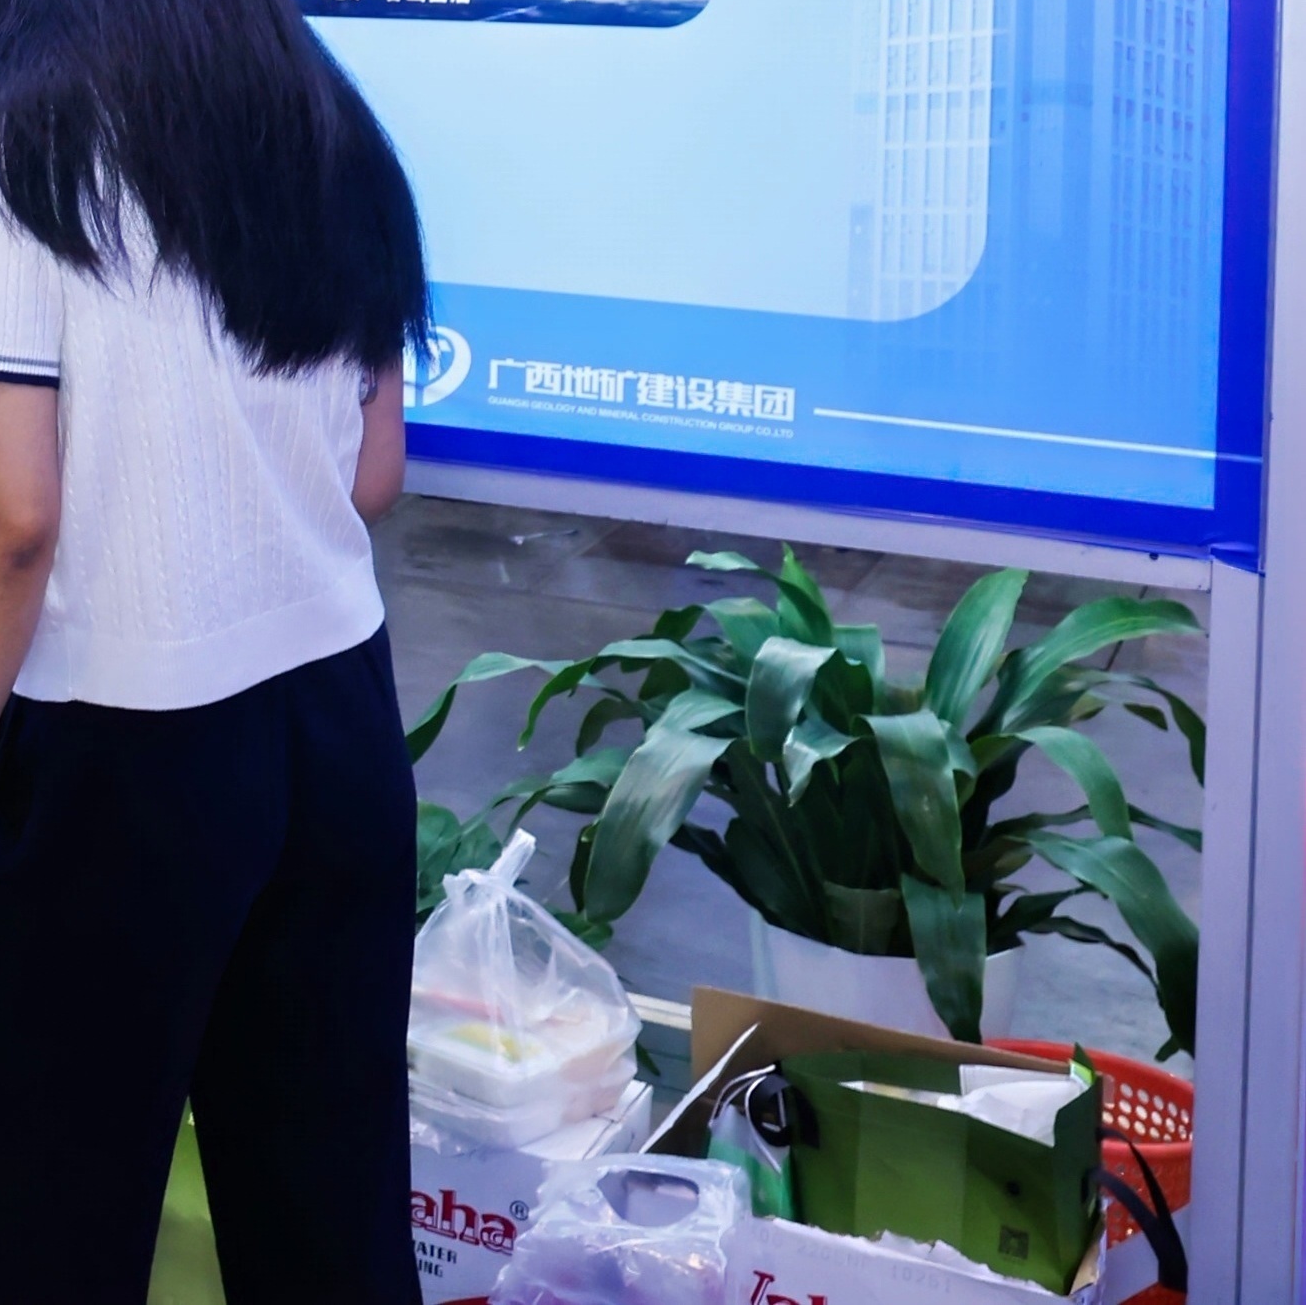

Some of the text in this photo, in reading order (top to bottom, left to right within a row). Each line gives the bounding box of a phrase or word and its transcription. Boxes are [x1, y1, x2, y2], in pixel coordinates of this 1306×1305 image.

[488, 358, 795, 422] 广西地矿建设集团
[488, 396, 530, 409] GUANGXI
[531, 400, 576, 414] GEOLOGY
[577, 405, 597, 416] AND
[599, 408, 639, 422] MINERAL
[641, 413, 717, 430] CONSTRUCTION
[719, 421, 754, 435] GROUP
[414, 1240, 457, 1264] ATER
